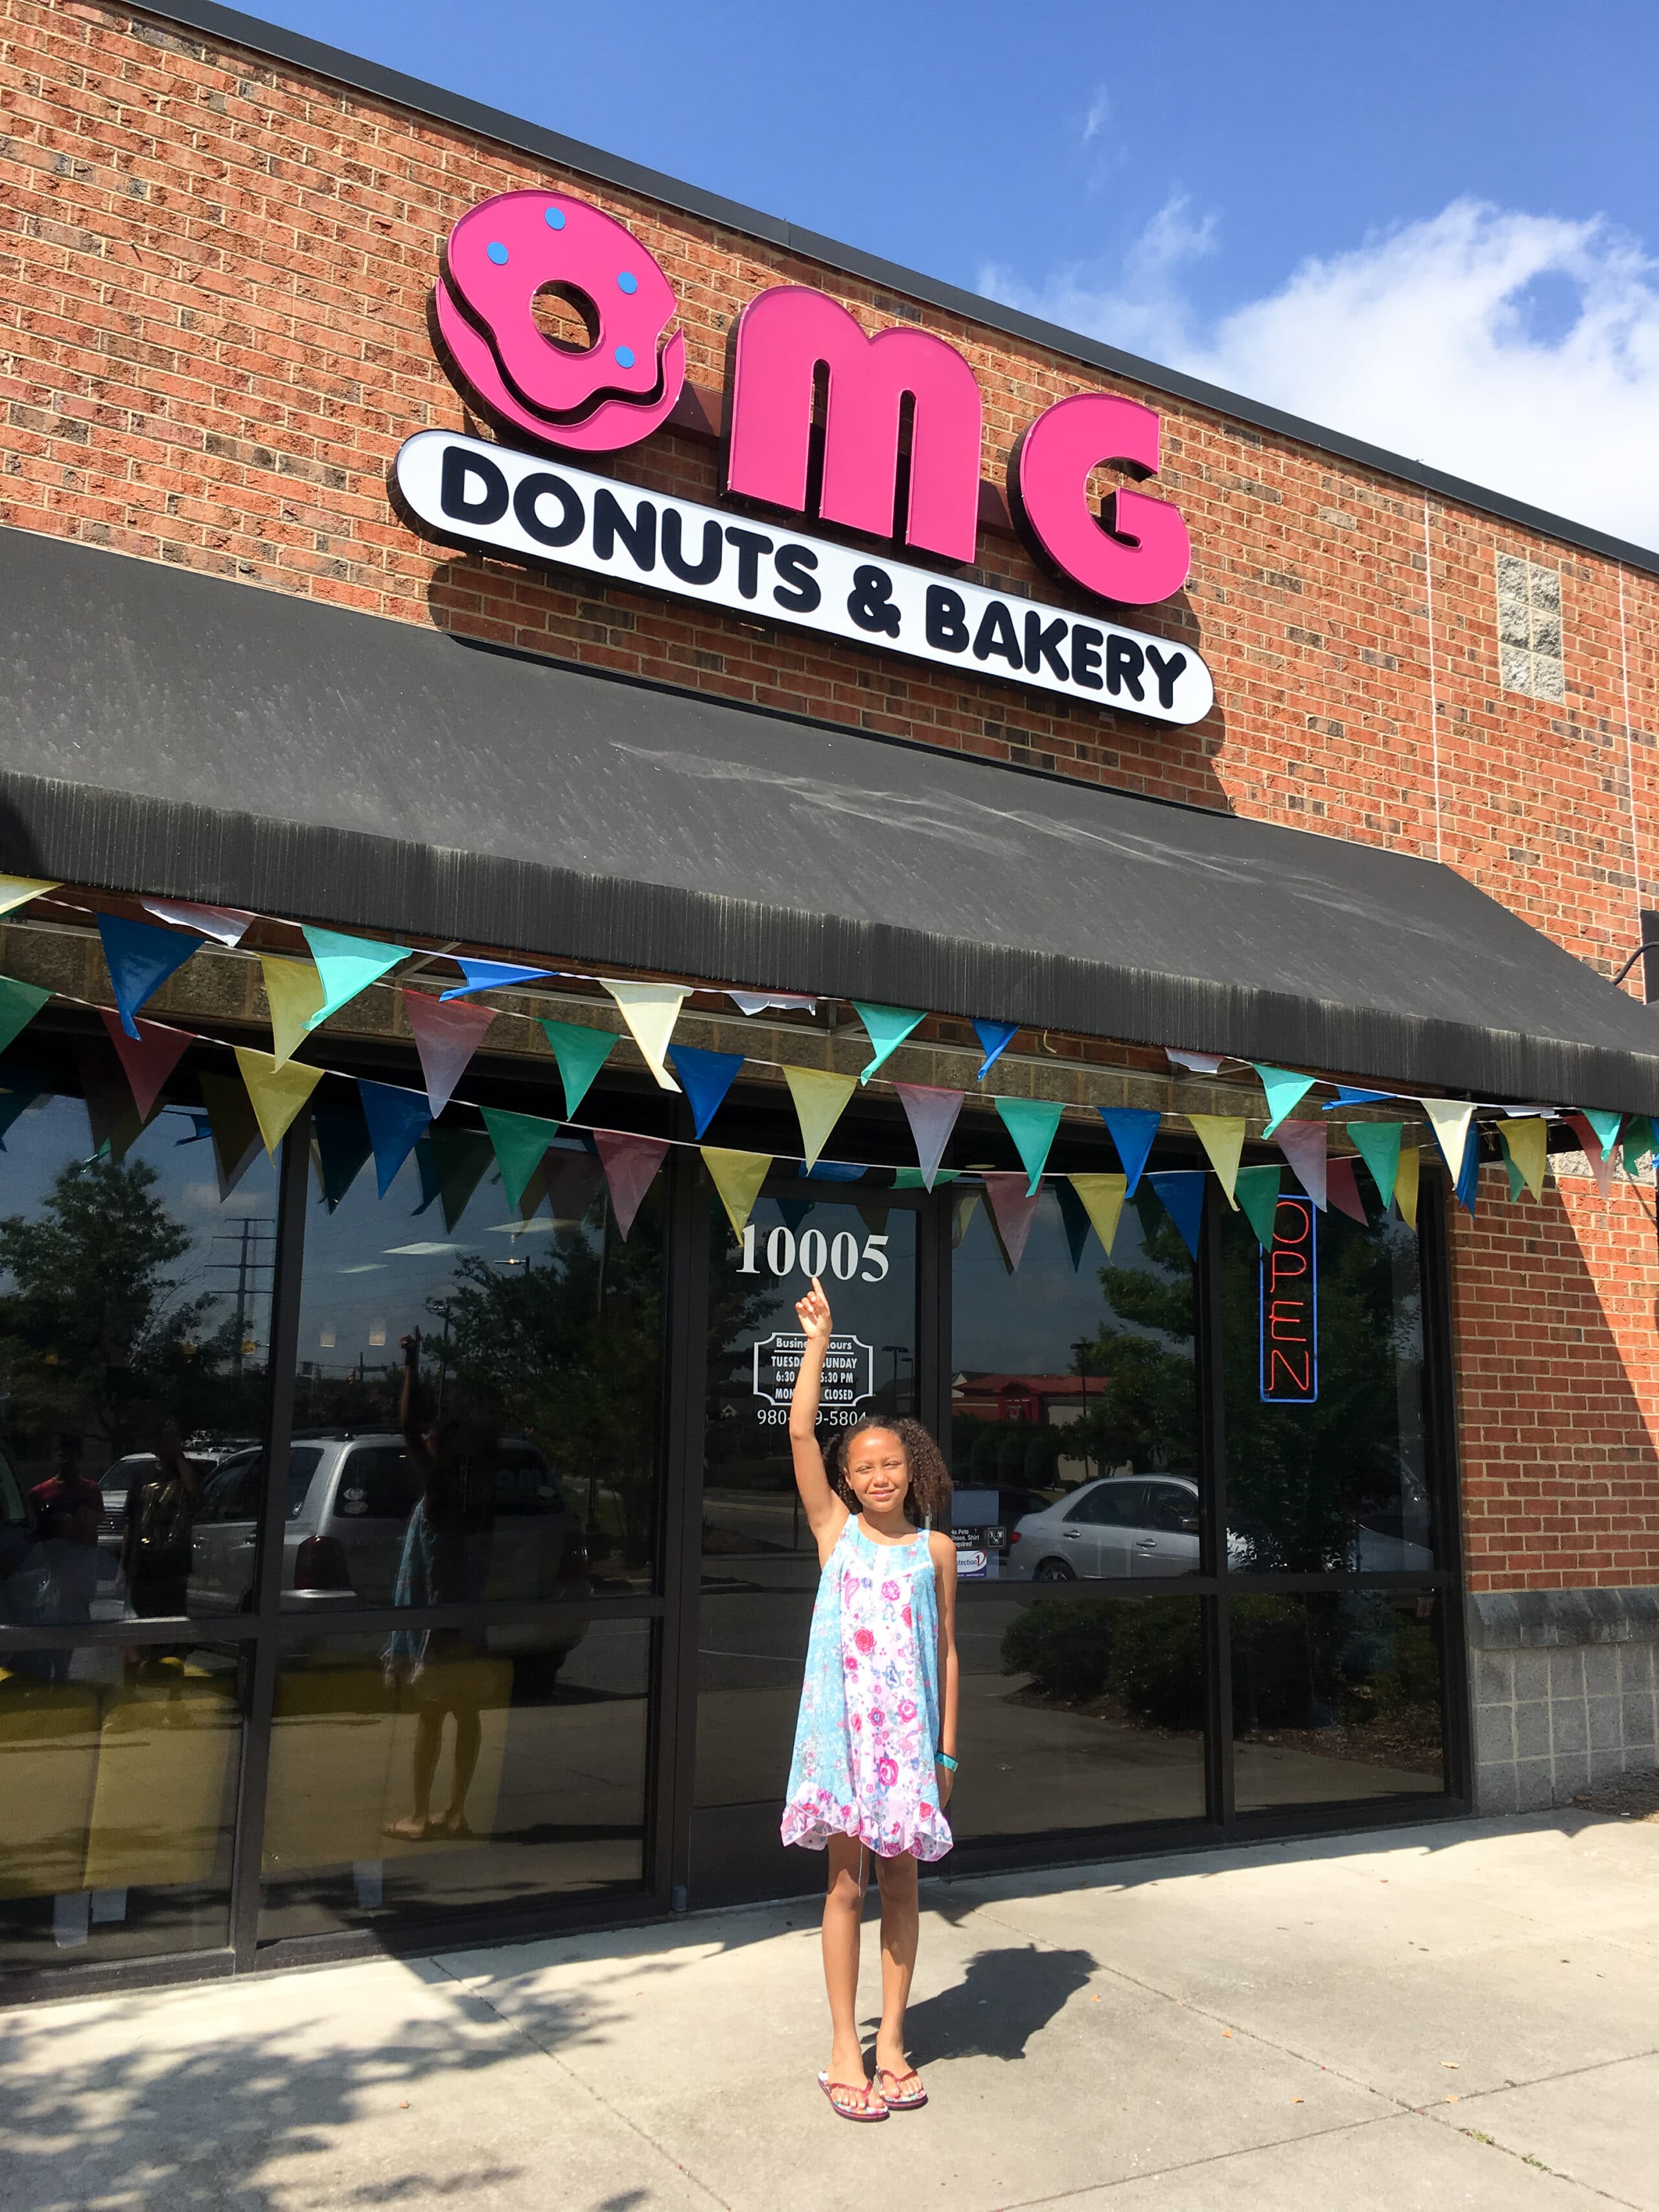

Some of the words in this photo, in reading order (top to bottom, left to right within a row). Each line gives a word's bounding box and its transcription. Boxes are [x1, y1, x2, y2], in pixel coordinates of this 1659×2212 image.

[435, 189, 1191, 605] OMG
[441, 445, 822, 614] DONUTS
[846, 564, 901, 639] &
[925, 584, 1187, 710] BAKERY
[736, 1223, 889, 1283] 10005
[1268, 1201, 1310, 1391] OPEN
[776, 1337, 807, 1349] Busine
[828, 1342, 852, 1350] ours
[771, 1356, 804, 1368] TUESD
[776, 1371, 796, 1382] 6:30
[820, 1371, 838, 1383] 5:30
[841, 1372, 853, 1384] PM
[774, 1388, 795, 1399] MON
[824, 1388, 853, 1400] CLOSED
[757, 1410, 866, 1426] 980-9-580
